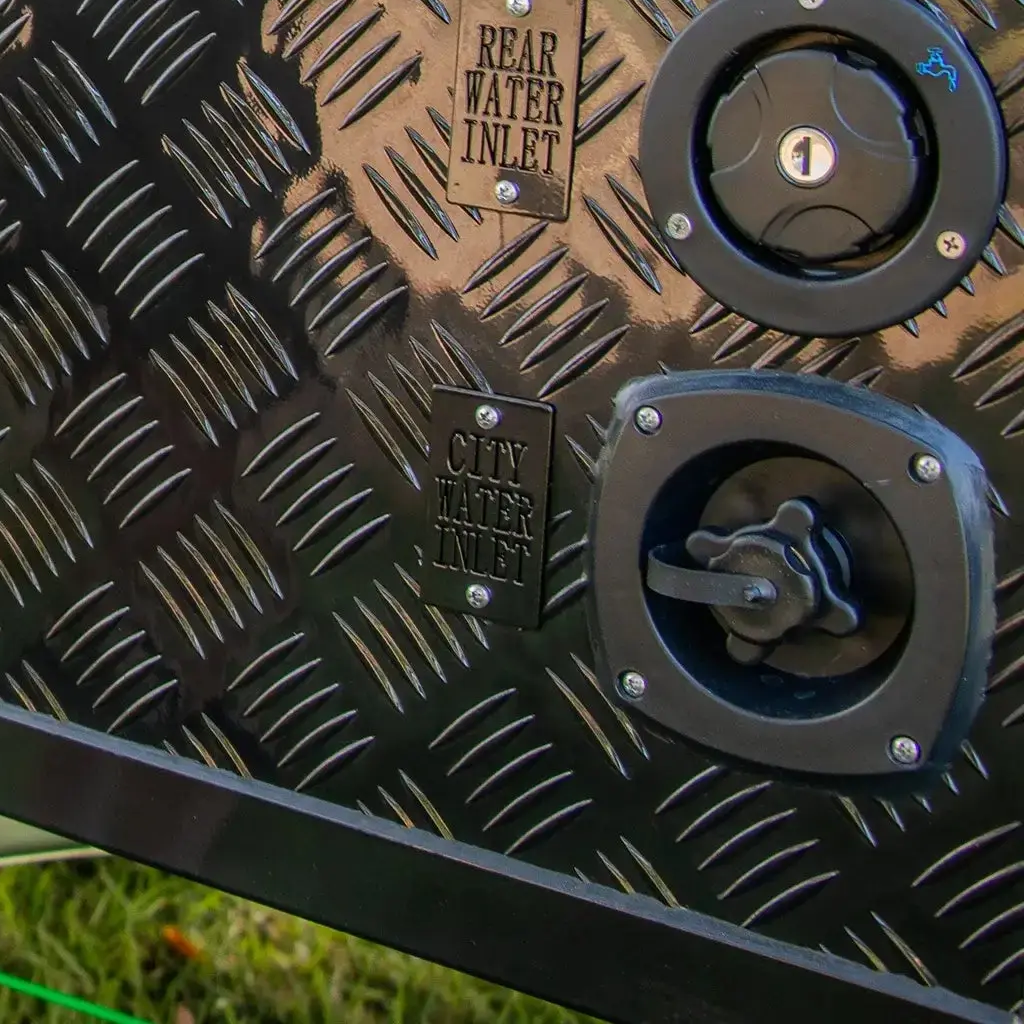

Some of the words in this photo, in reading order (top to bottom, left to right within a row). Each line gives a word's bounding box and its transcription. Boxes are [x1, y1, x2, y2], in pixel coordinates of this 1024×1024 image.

[476, 23, 559, 77] REAR
[464, 69, 565, 127] WATER
[460, 118, 561, 176] INLET
[446, 432, 528, 488] CITY
[434, 475, 535, 541] WATER
[432, 523, 532, 587] INLET
